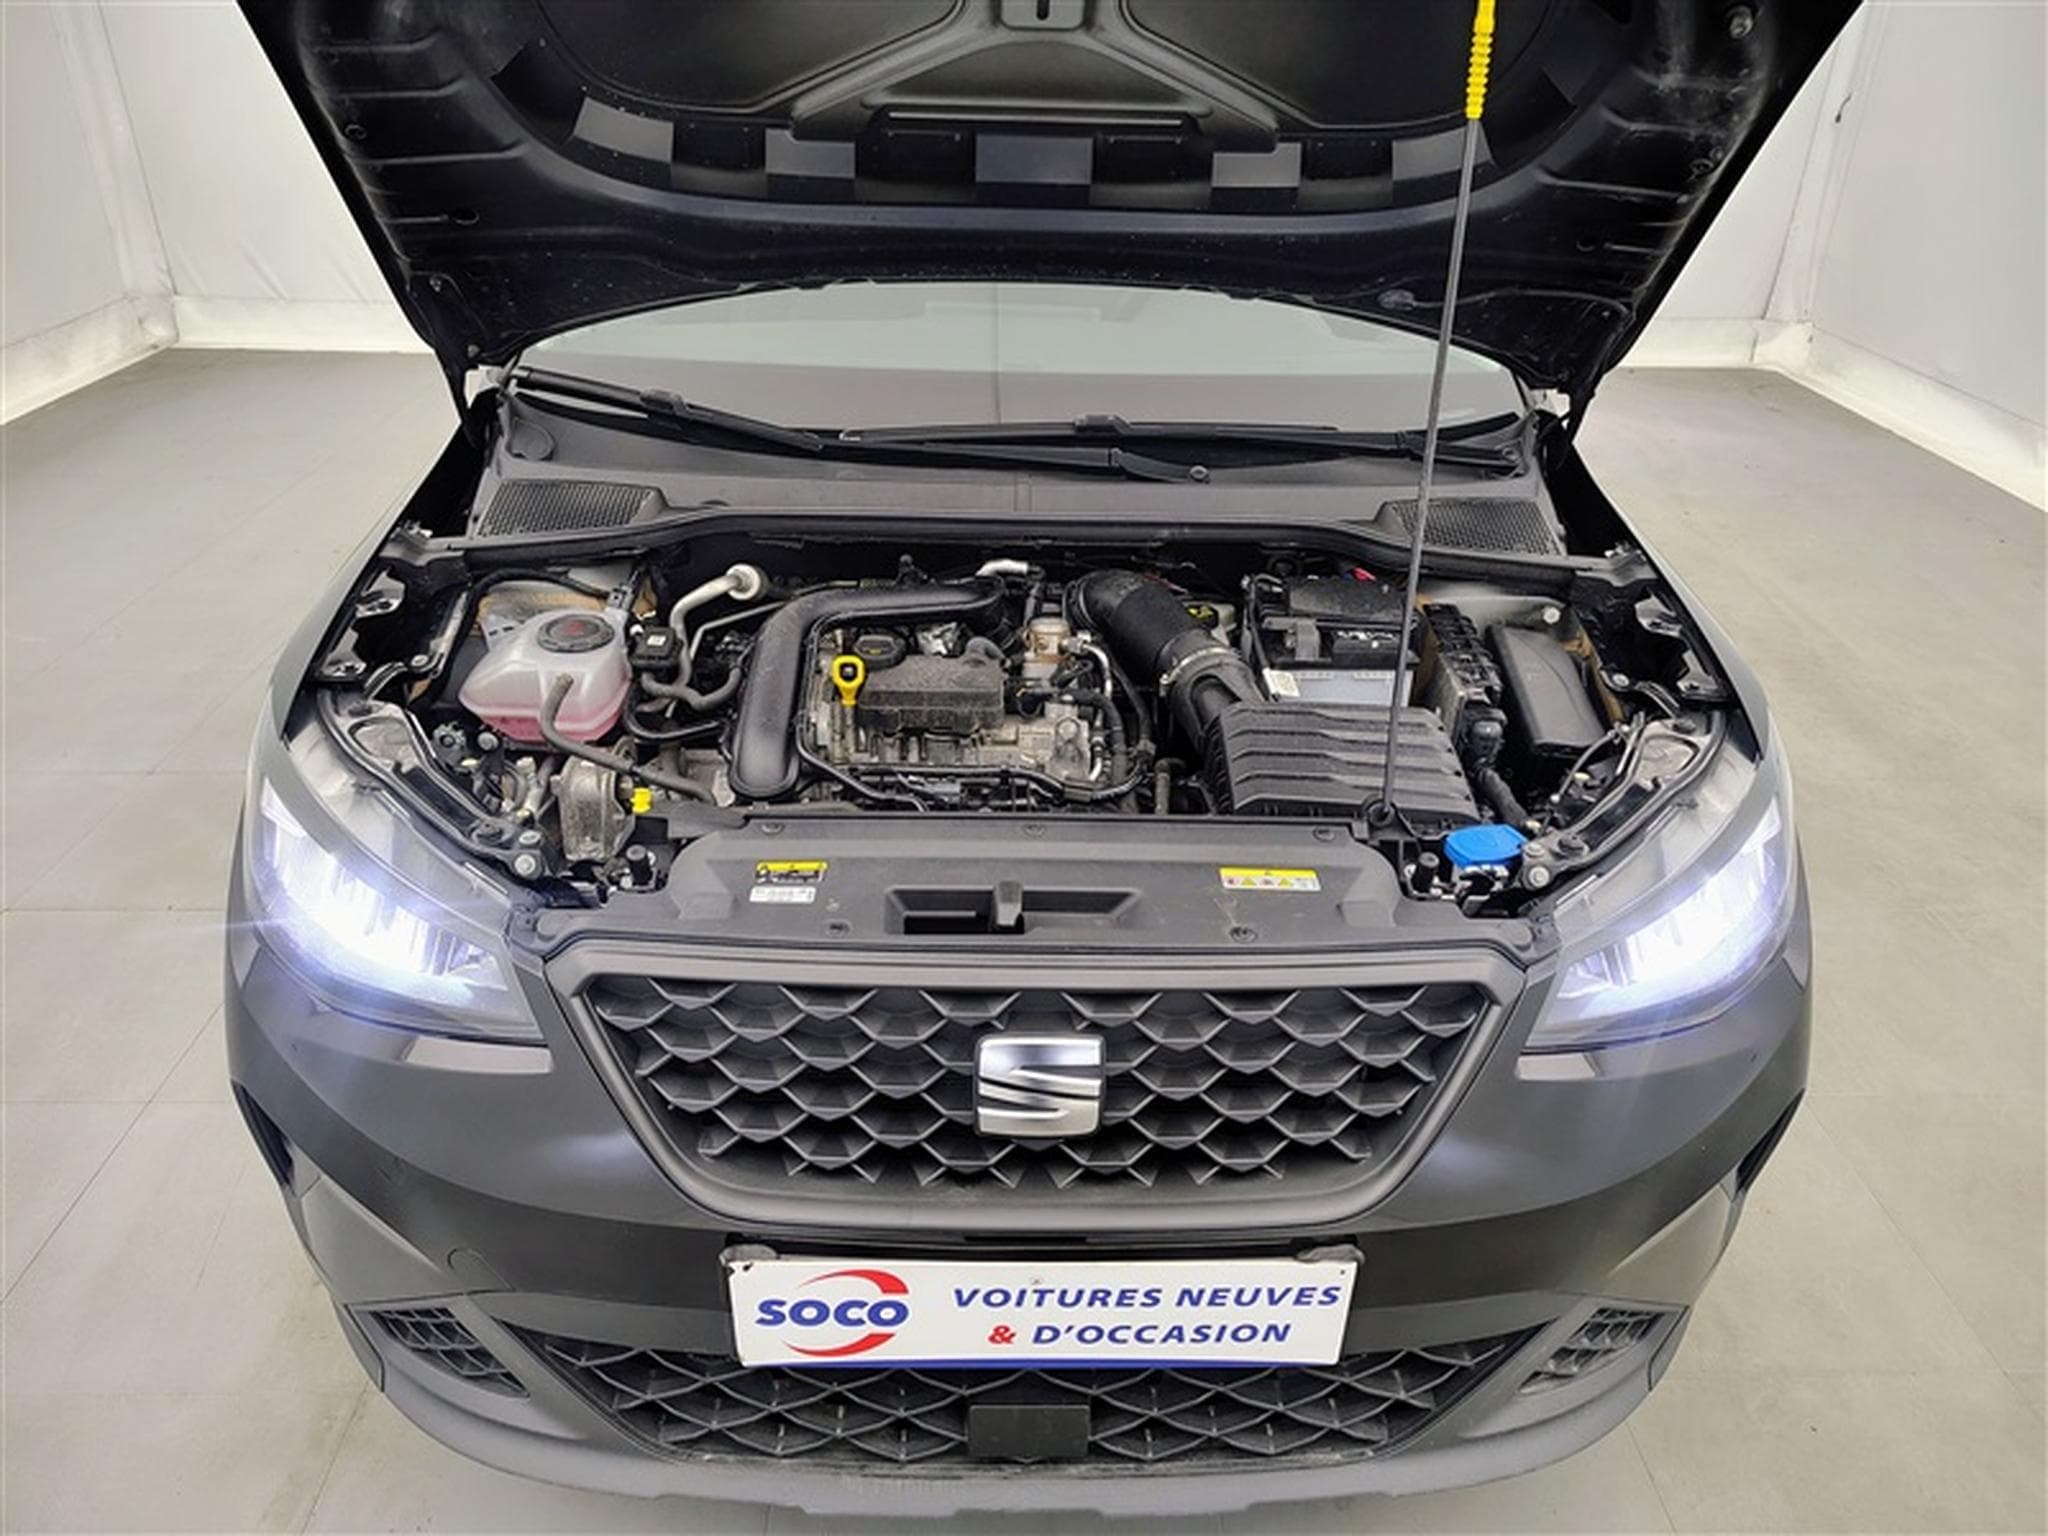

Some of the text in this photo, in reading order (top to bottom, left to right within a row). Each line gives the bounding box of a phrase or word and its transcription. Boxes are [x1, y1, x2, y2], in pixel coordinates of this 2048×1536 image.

[953, 1285, 1342, 1309] VOITURES NEUVES
[755, 1298, 910, 1328] SOCO
[986, 1322, 1292, 1346] & D'OCCASION
